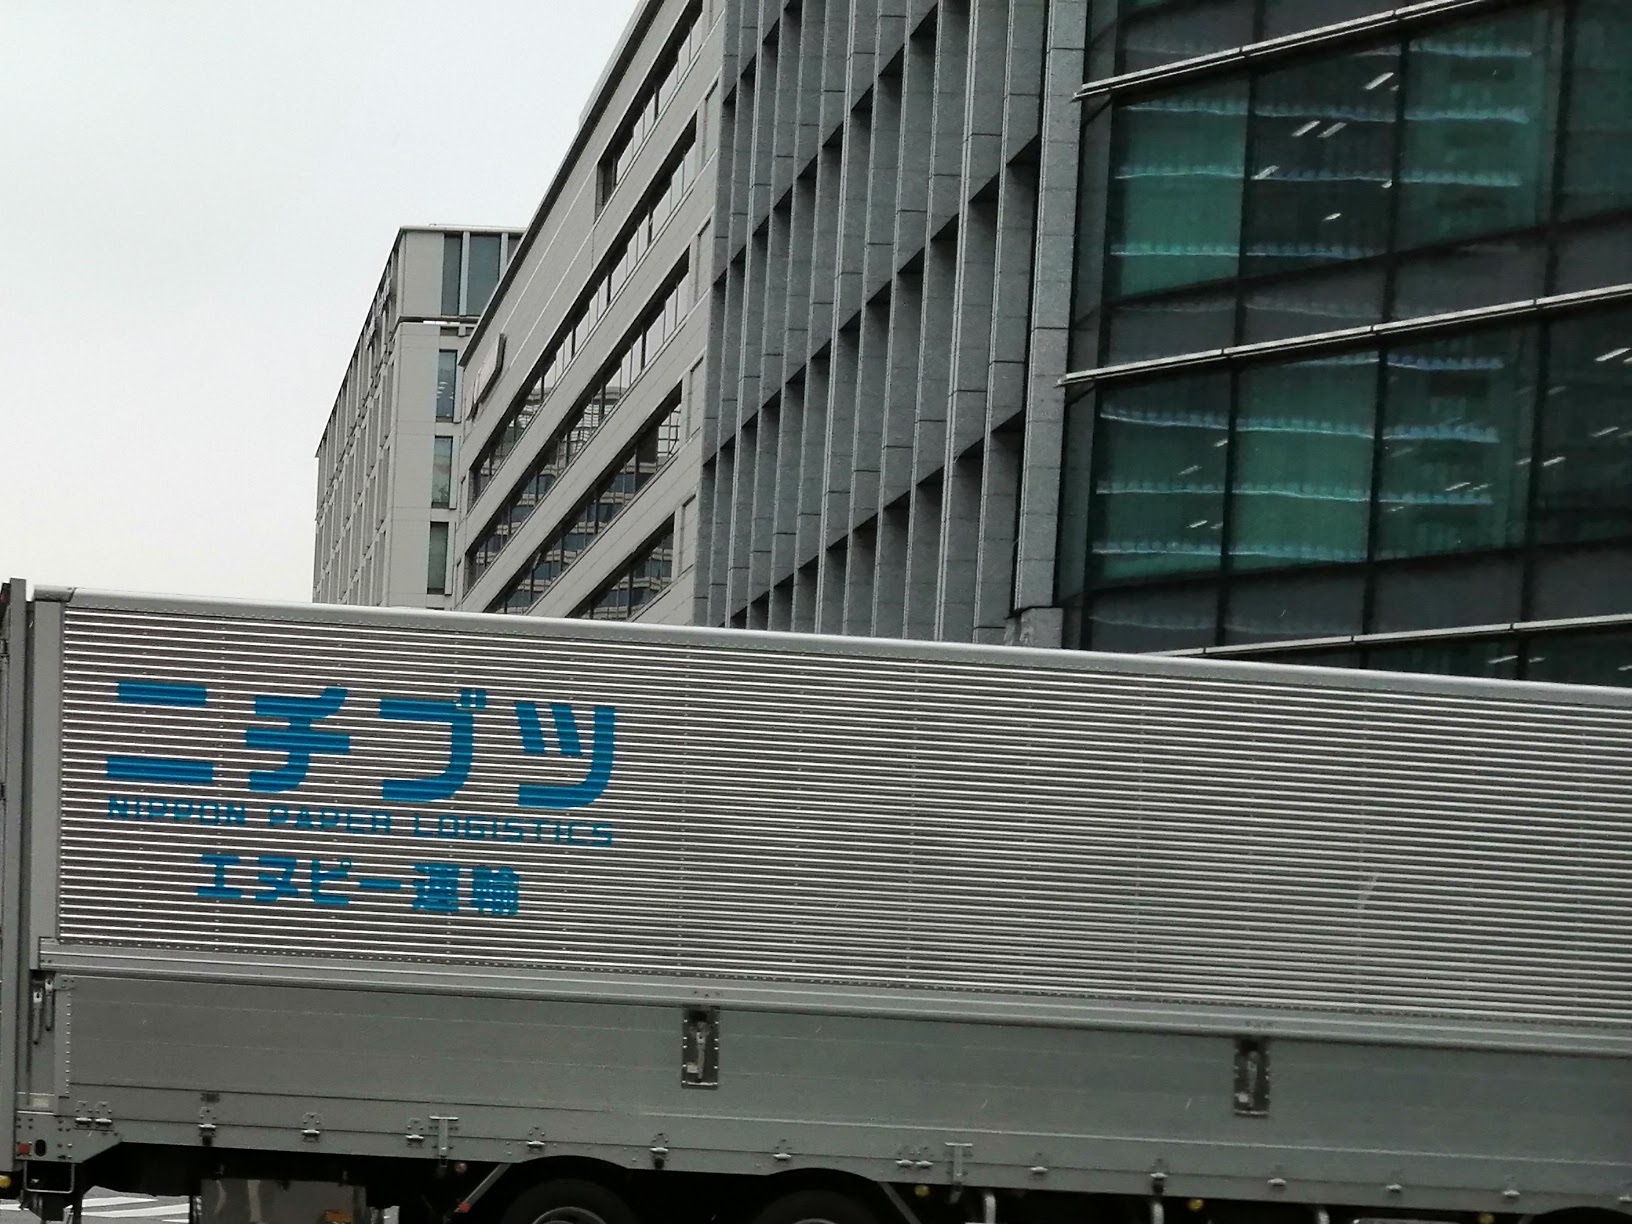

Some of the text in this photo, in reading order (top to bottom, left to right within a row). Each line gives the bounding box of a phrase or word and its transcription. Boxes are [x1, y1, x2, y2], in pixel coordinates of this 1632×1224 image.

[106, 680, 616, 809] ニチブツ
[107, 797, 614, 847] NIPPON PAPER LOGISTICS
